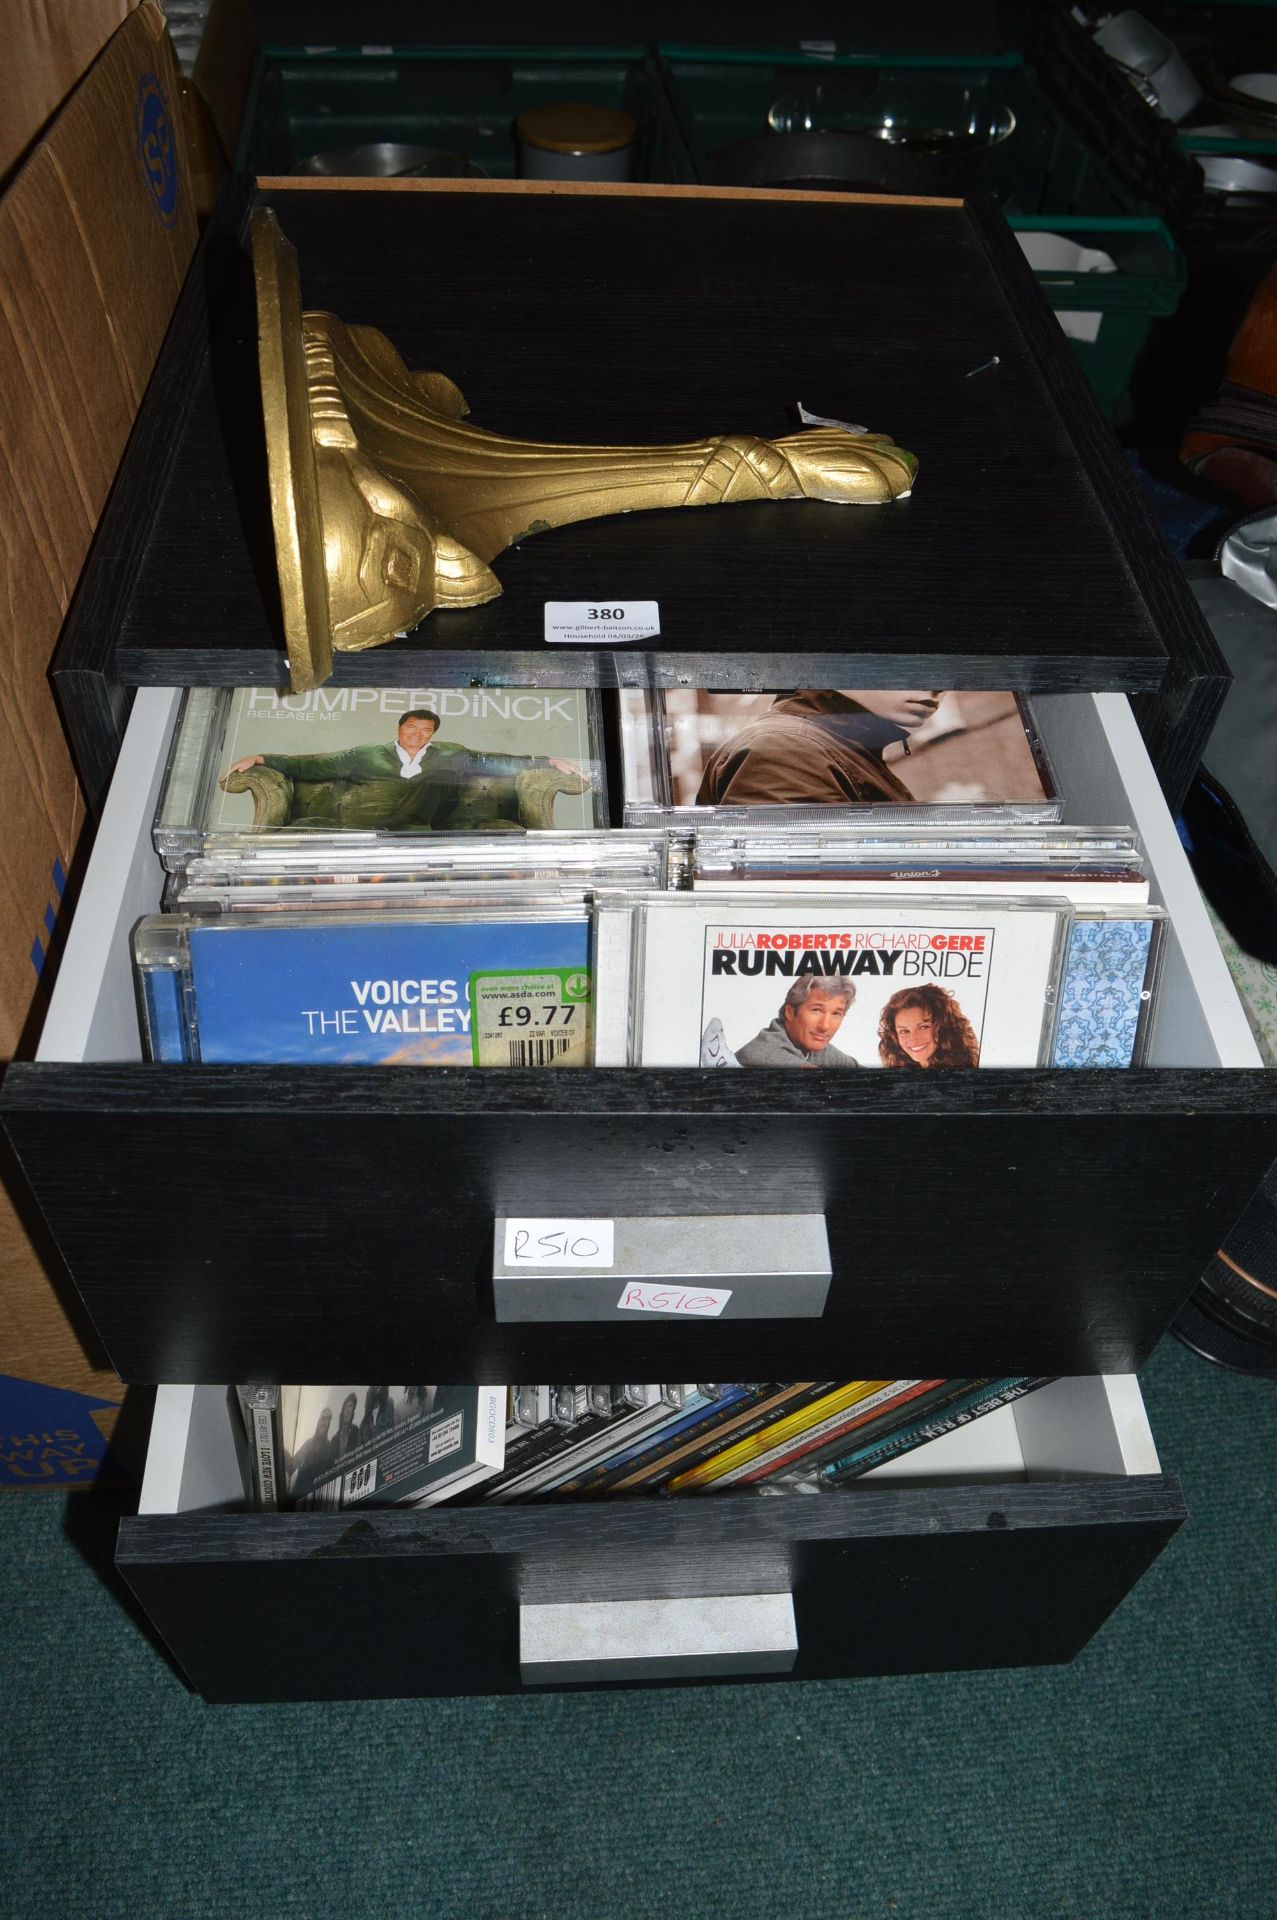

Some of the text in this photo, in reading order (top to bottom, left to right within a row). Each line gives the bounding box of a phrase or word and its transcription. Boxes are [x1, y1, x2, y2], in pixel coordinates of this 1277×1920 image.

[587, 608, 625, 620] 380
[247, 710, 342, 721] RELEASE ME
[351, 980, 457, 1006] VOICES
[521, 983, 545, 991] choice
[481, 990, 556, 1000] www.asda.com
[301, 1010, 360, 1035] THE
[498, 1005, 576, 1027] £9.77
[1005, 1386, 1028, 1402] THE
[971, 1398, 1005, 1418] BEST
[955, 1411, 972, 1424] OF
[261, 1451, 271, 1465] LOVE
[7, 1458, 99, 1478] UP
[263, 1467, 272, 1478] NEW
